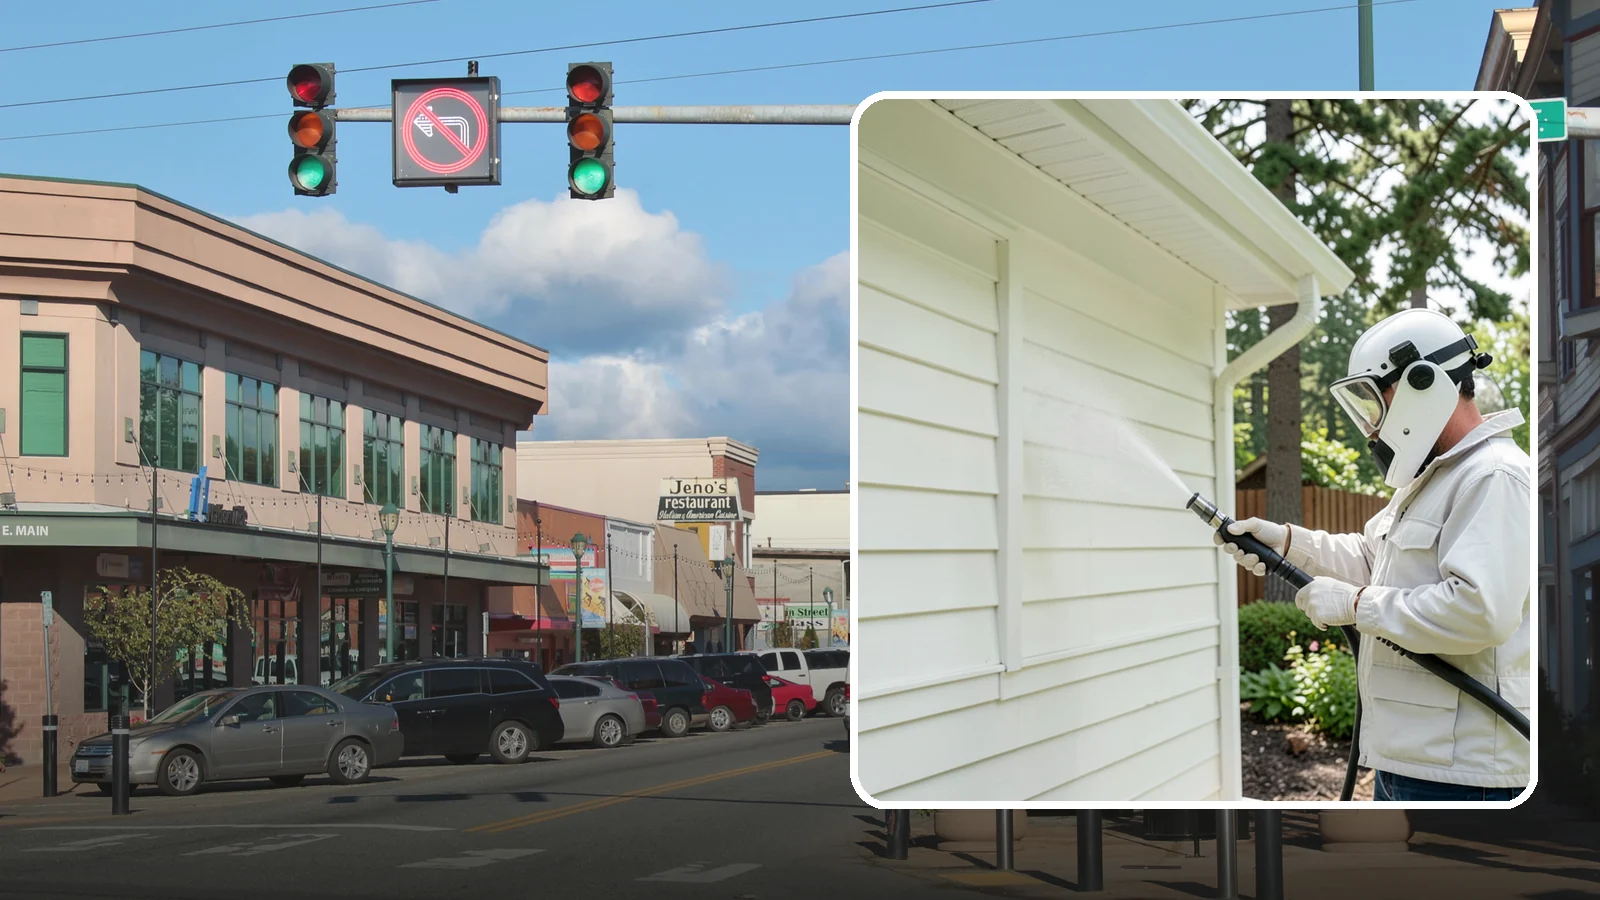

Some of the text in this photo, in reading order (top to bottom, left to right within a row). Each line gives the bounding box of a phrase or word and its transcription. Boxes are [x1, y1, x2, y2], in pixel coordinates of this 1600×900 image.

[670, 480, 727, 494] Jeno's
[665, 496, 731, 509] restaurant
[686, 509, 714, 519] American
[715, 509, 738, 519] Cuisine
[2, 525, 49, 536] E. MAIN
[797, 607, 828, 617] Street
